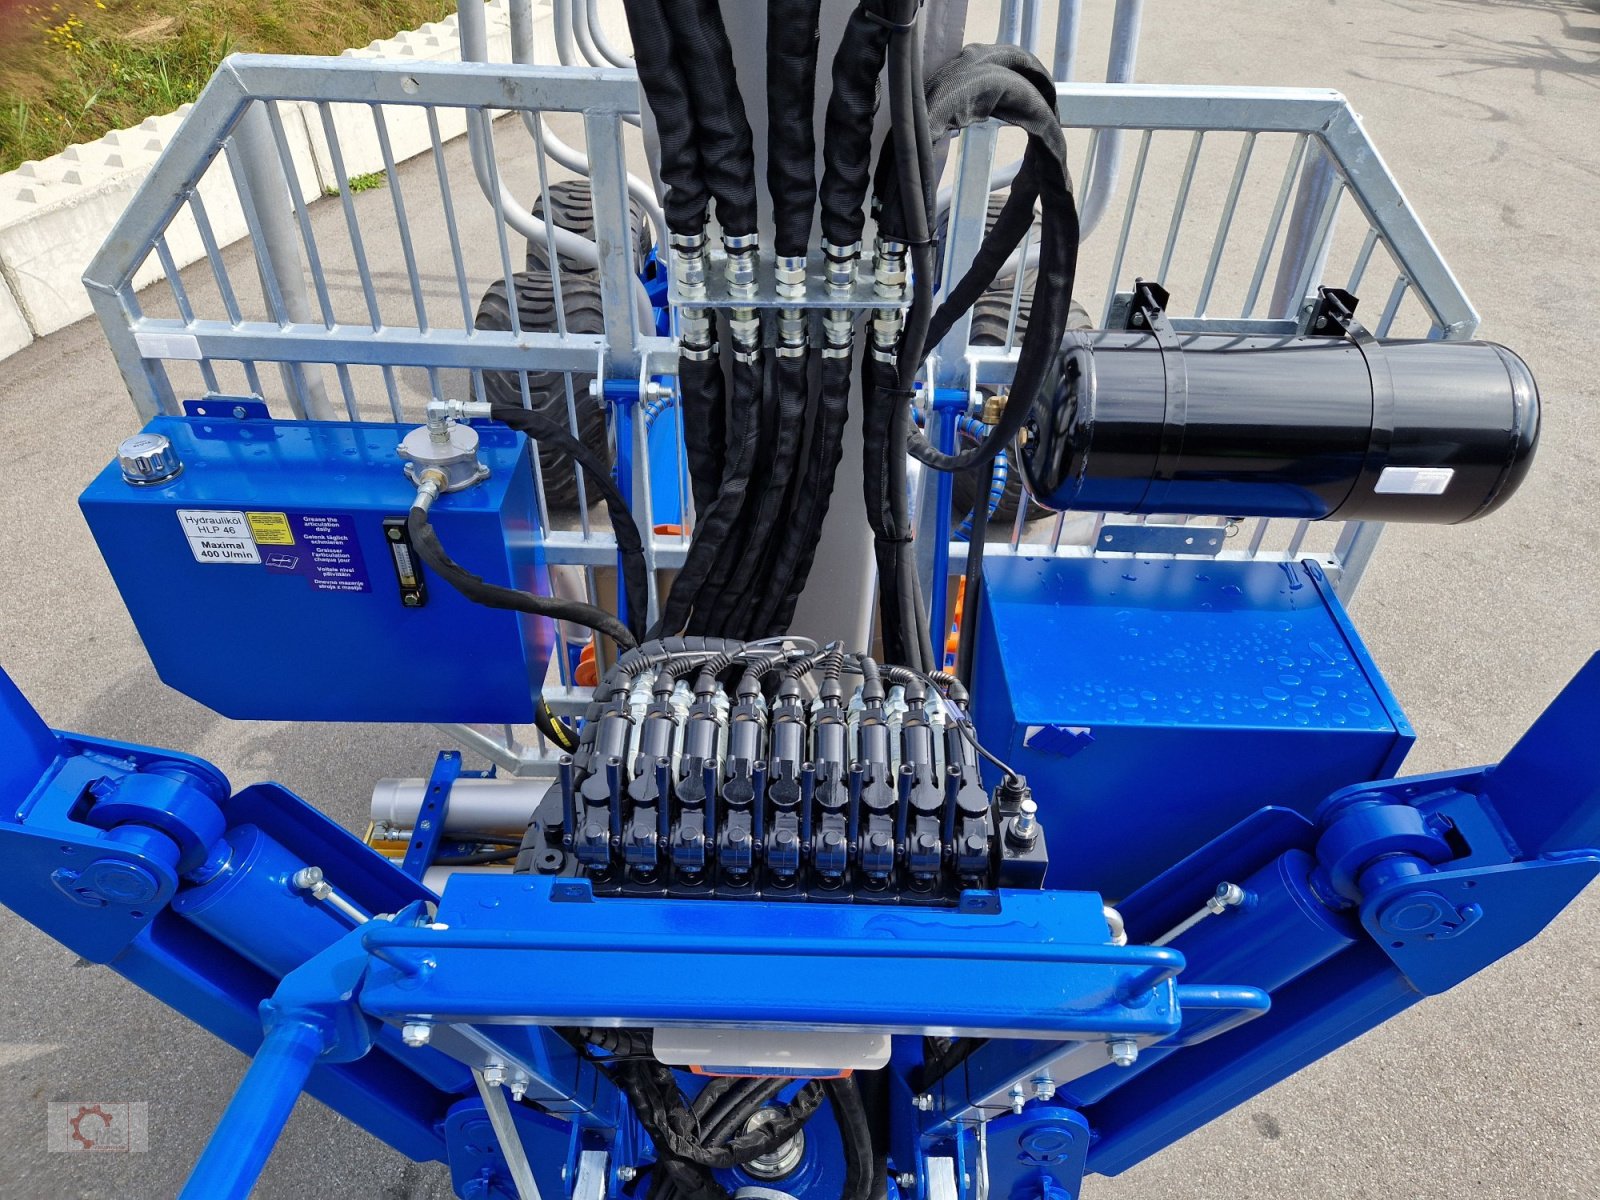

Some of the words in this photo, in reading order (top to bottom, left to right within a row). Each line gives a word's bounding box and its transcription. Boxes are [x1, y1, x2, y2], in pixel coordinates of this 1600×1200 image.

[184, 515, 242, 525] Hydrauliköl
[198, 526, 220, 534] HLP
[223, 526, 236, 534] 46
[201, 541, 245, 549] Maximal
[201, 550, 220, 558] 400
[223, 550, 253, 558] U/min
